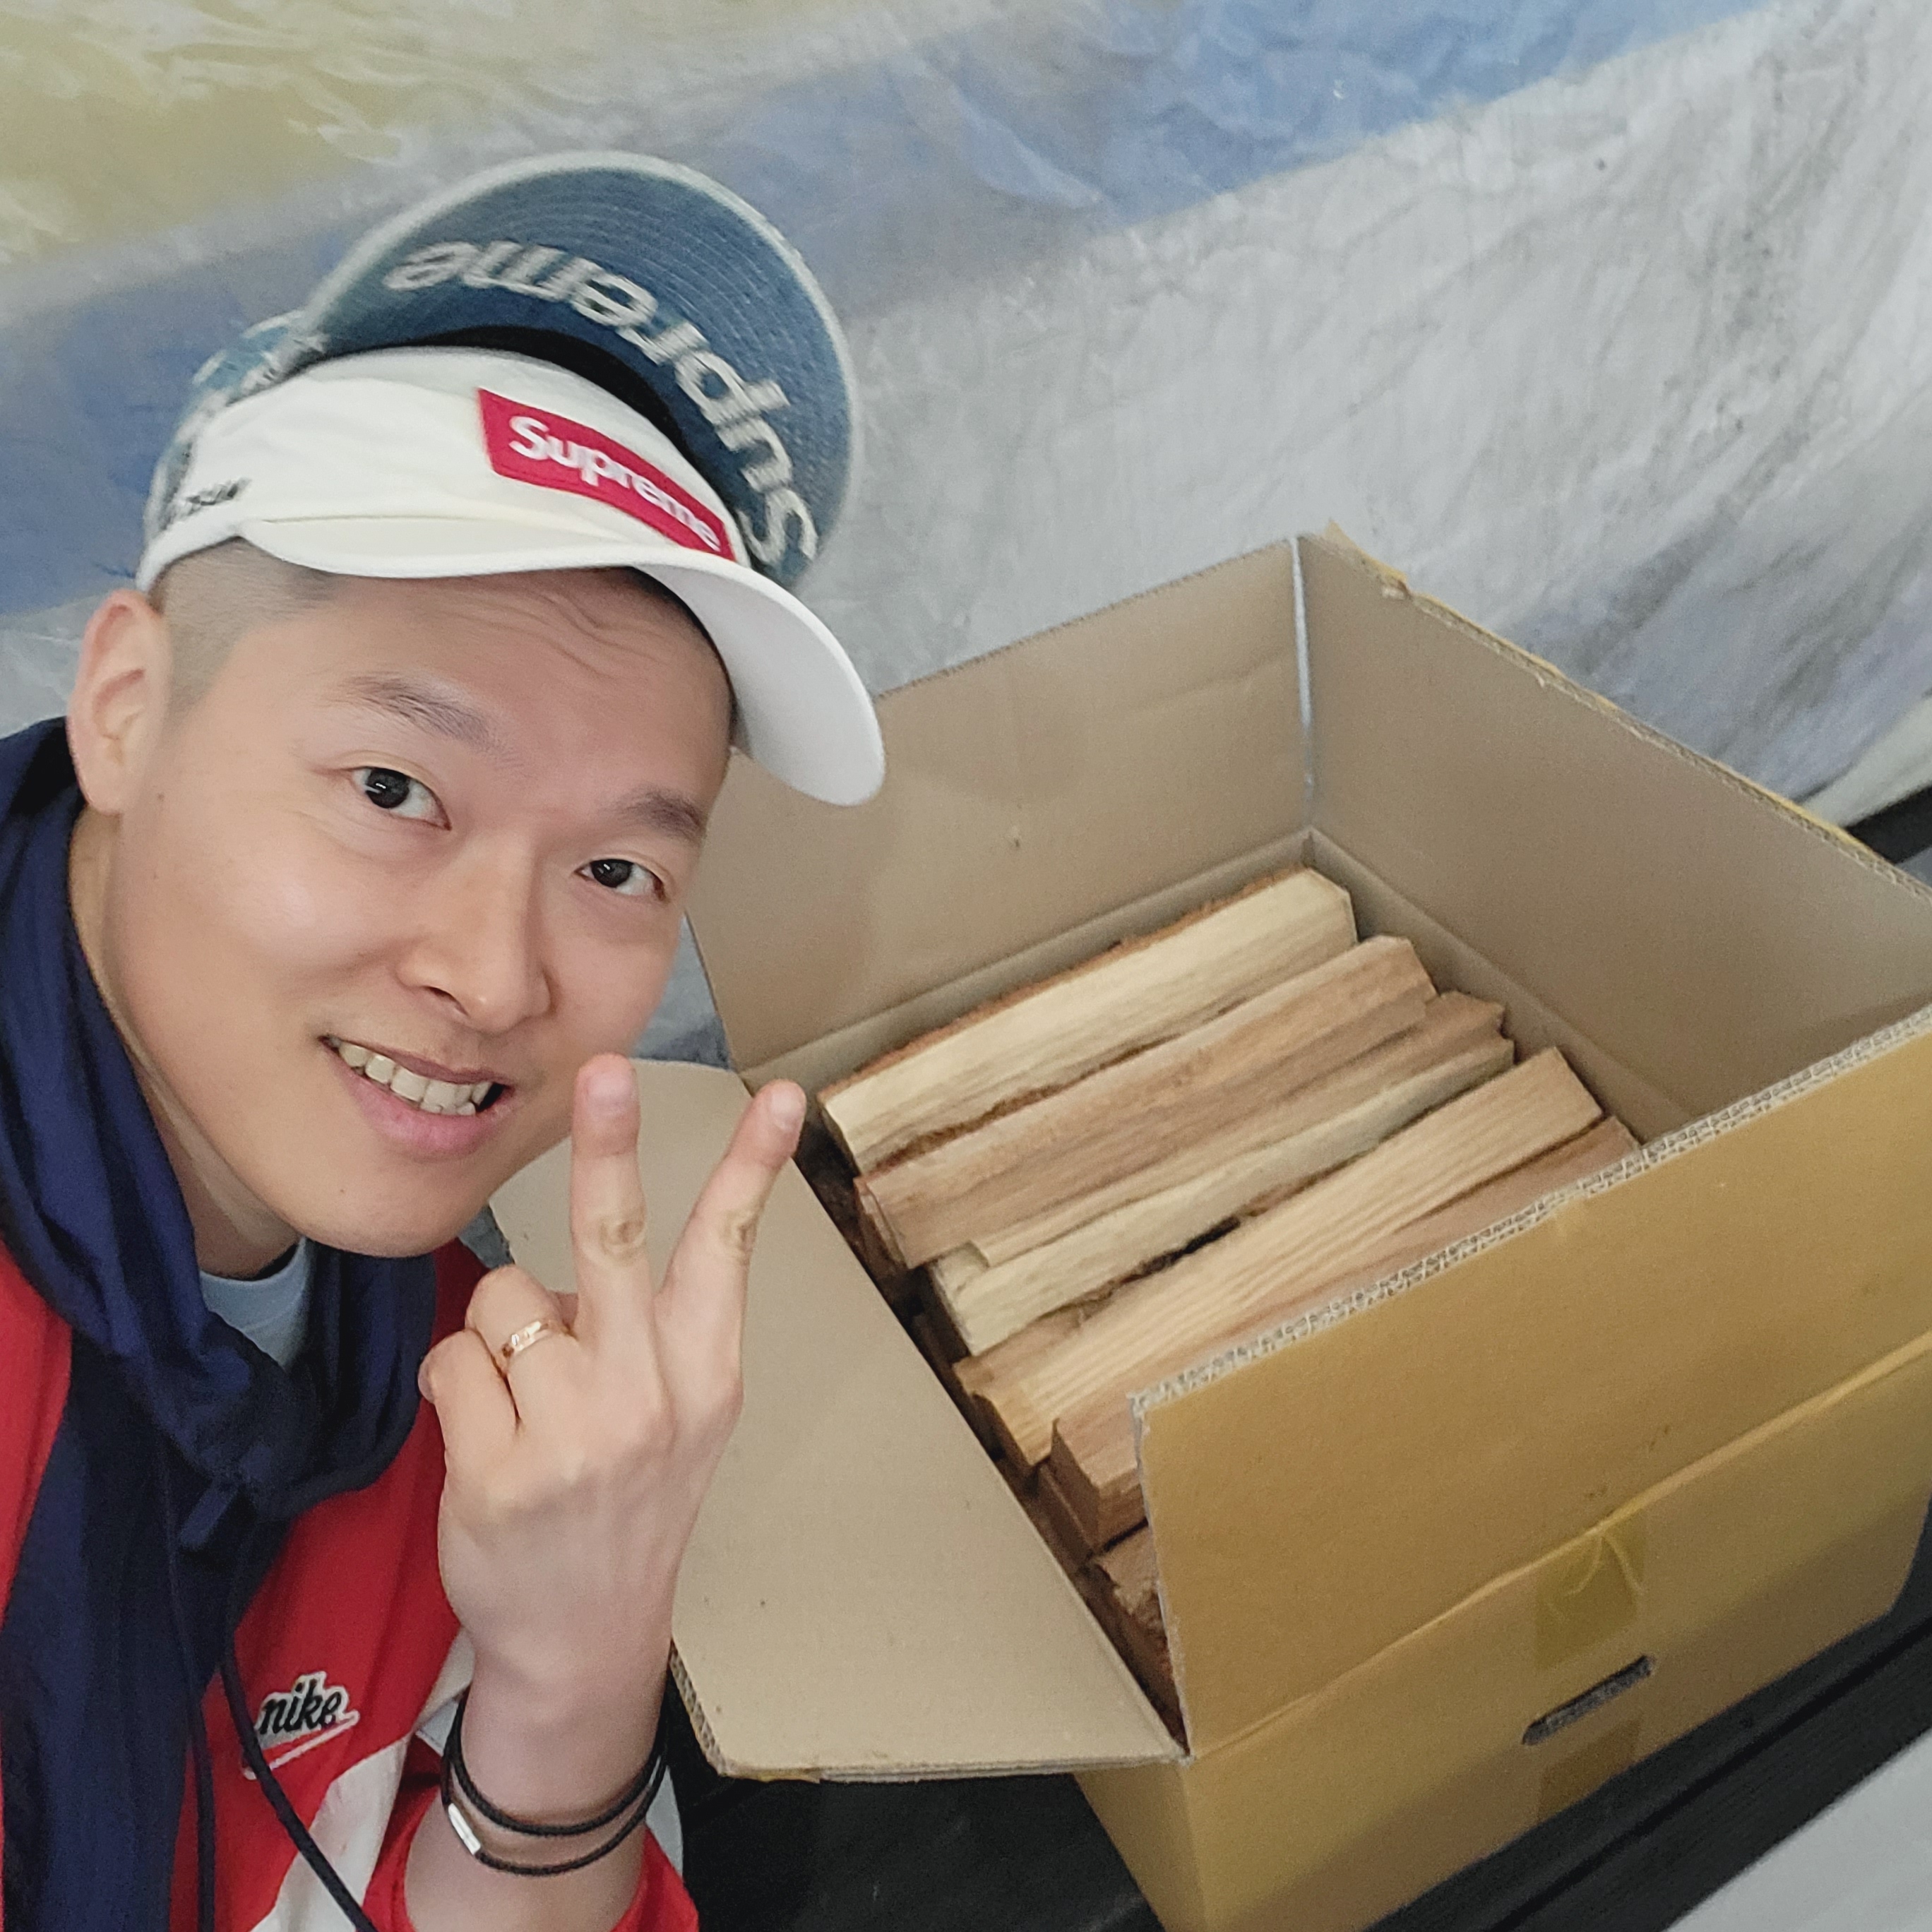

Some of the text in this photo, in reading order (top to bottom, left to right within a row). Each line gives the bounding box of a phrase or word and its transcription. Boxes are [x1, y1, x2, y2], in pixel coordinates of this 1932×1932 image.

[383, 240, 818, 563] Supreme
[508, 415, 721, 552] Supreme
[259, 1678, 342, 1735] nike
